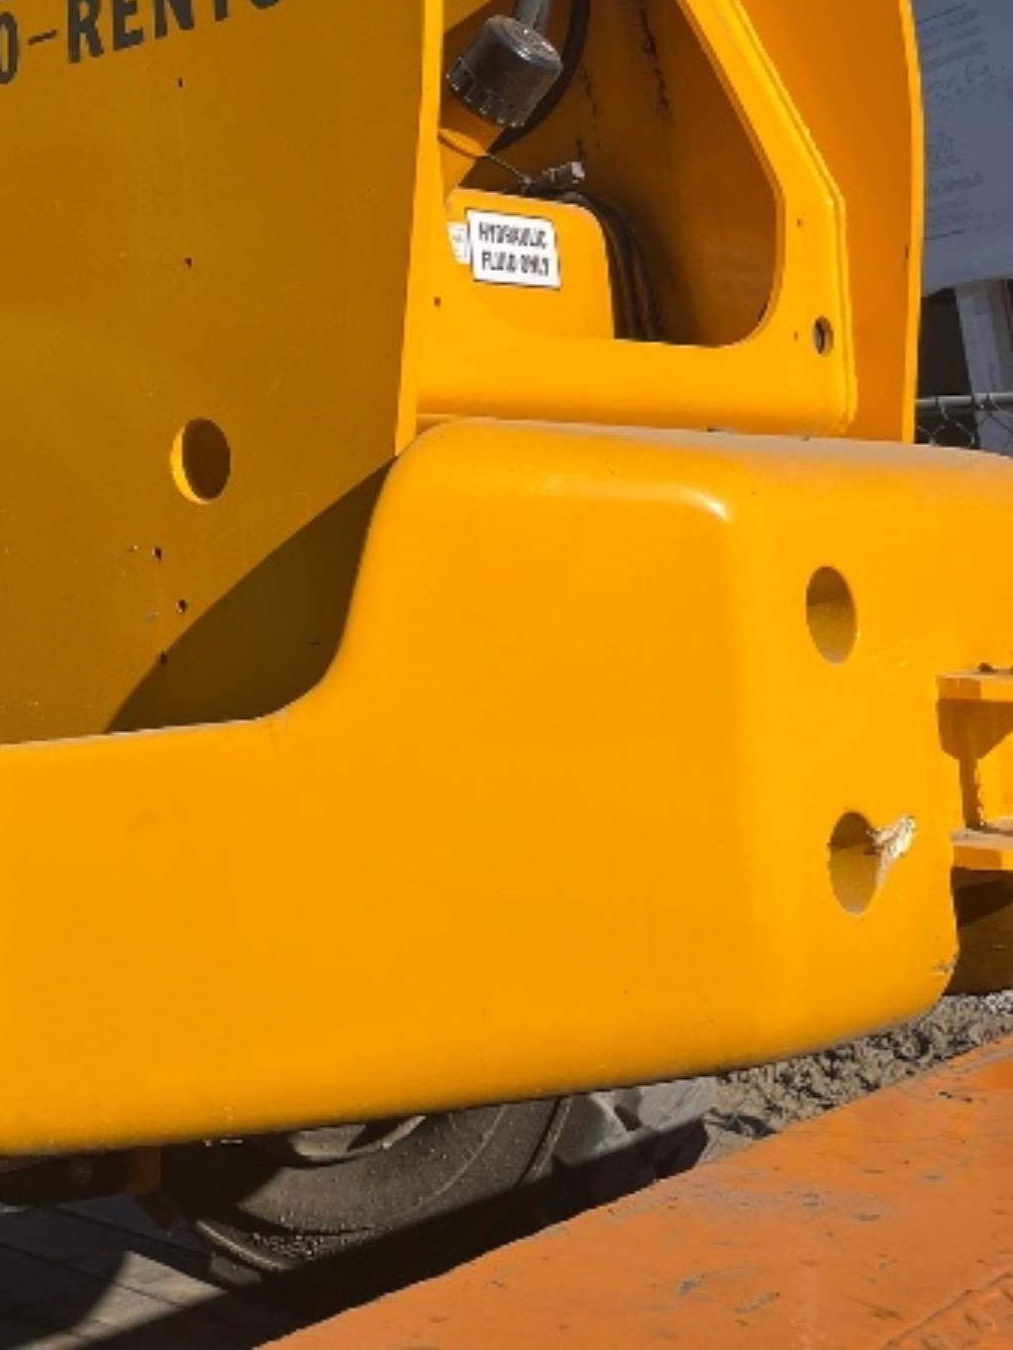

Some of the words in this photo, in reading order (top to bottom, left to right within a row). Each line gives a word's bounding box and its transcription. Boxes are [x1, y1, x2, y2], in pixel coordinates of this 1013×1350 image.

[478, 221, 547, 249] HYDRAULIC
[482, 250, 516, 274] FLUID
[520, 254, 550, 277] ONLY
